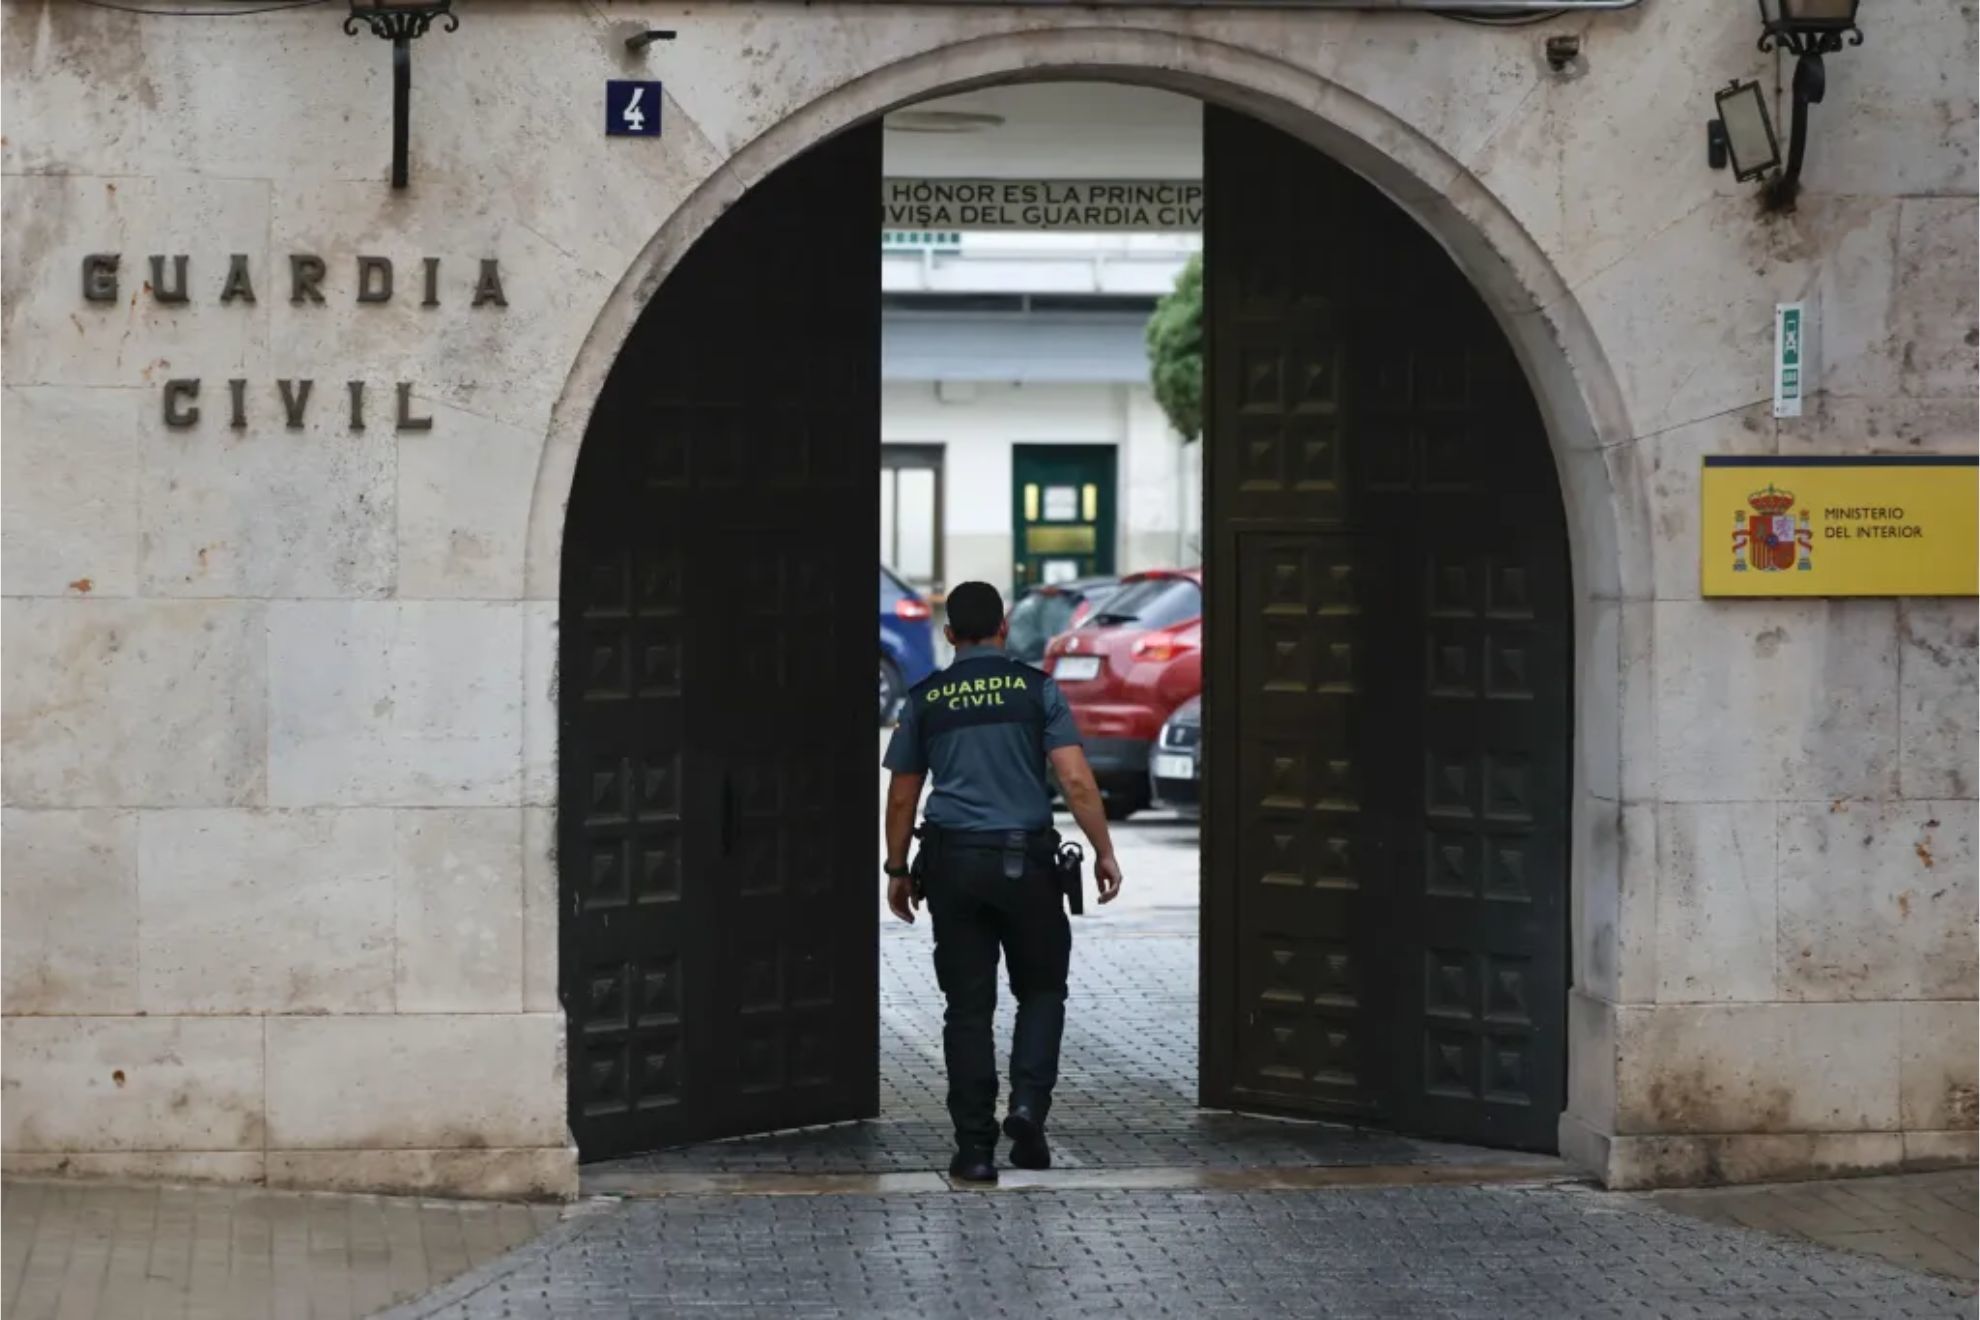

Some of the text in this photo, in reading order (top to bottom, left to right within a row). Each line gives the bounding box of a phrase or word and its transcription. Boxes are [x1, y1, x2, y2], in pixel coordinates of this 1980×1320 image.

[623, 88, 646, 130] 4
[893, 184, 1202, 205] HONOR ES LA PRINCIP
[960, 205, 1016, 225] DEL
[1022, 205, 1150, 225] GUARDIA
[1157, 206, 1203, 226] CIV
[81, 253, 510, 307] GUARDIA
[163, 378, 433, 431] CIVIL
[1824, 507, 1905, 520] MINISTERIO
[1824, 526, 1923, 538] DEL INTERIOR
[925, 675, 1027, 702] GUARDIA
[948, 692, 1005, 710] CIVIL
